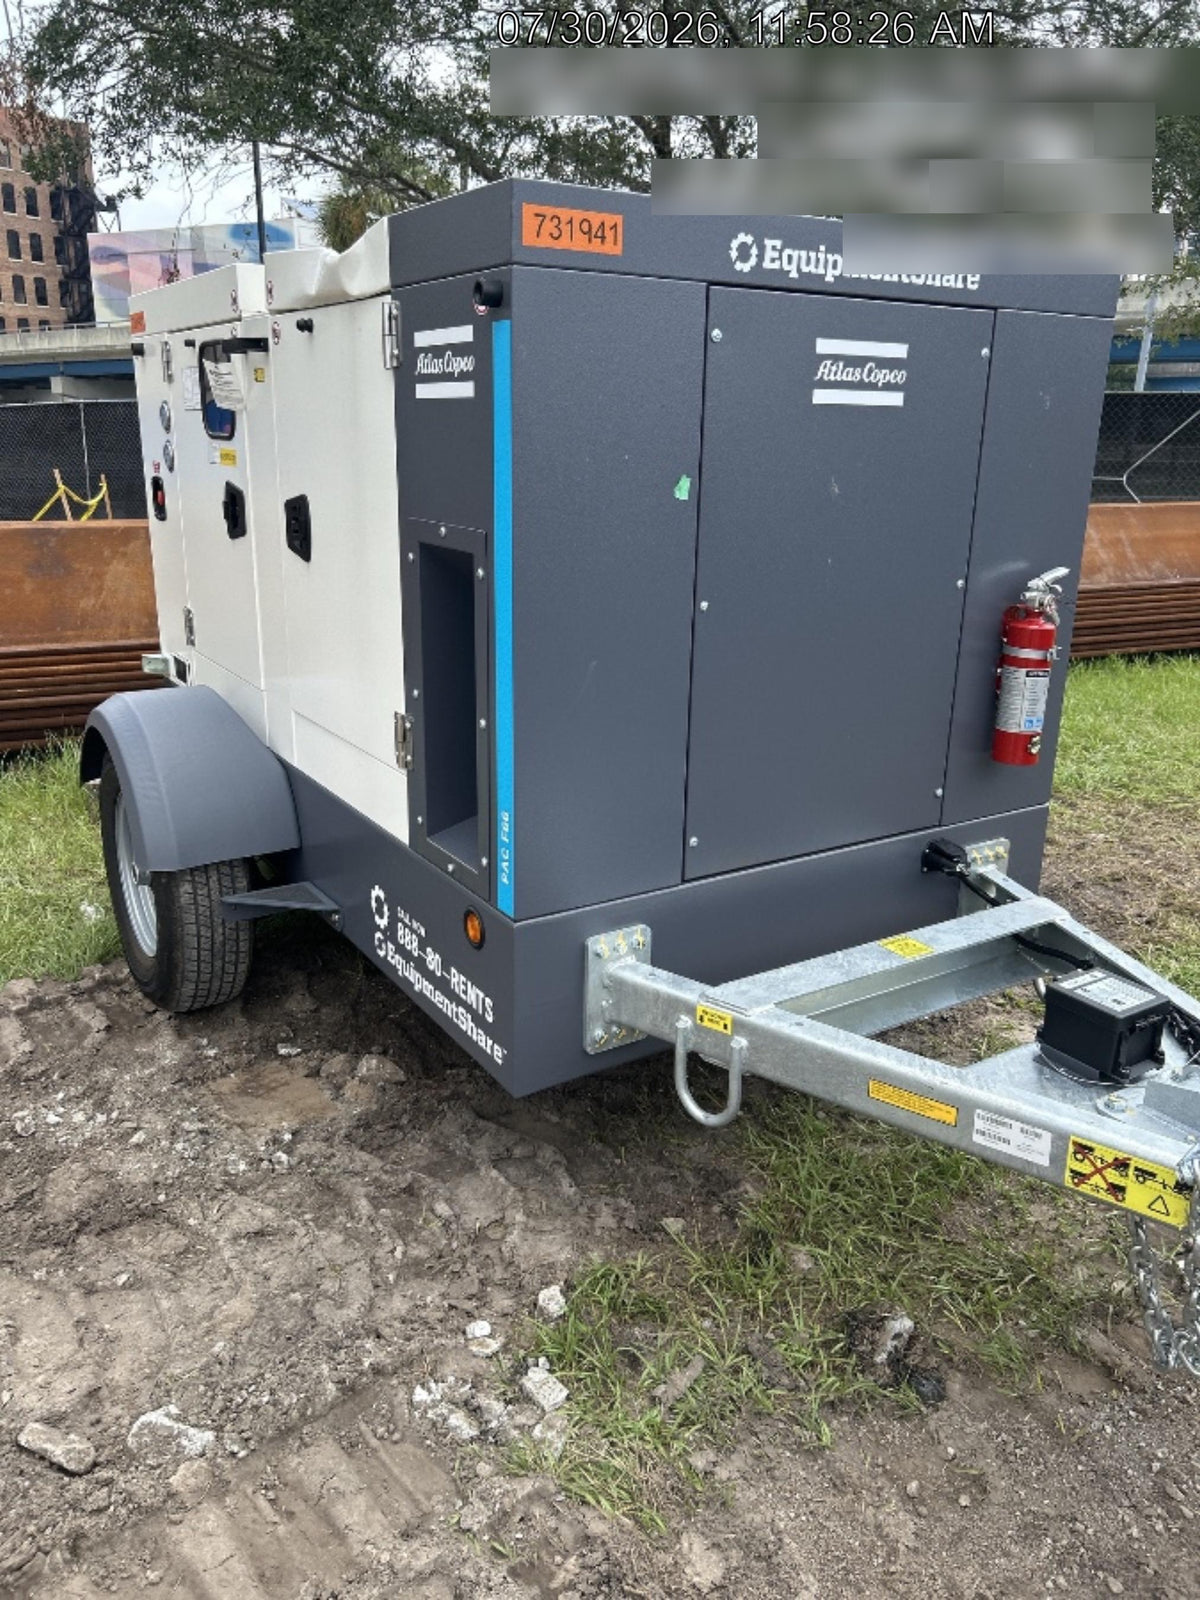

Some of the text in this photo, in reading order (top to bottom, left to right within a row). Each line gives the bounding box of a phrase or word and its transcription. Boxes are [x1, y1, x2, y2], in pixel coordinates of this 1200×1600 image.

[533, 213, 618, 246] 731941
[414, 350, 475, 378] Atlas Copco
[814, 360, 907, 387] Atlas Copco
[397, 922, 494, 1023] 888-80-RENTS
[387, 941, 504, 1066] EquipmentShare
